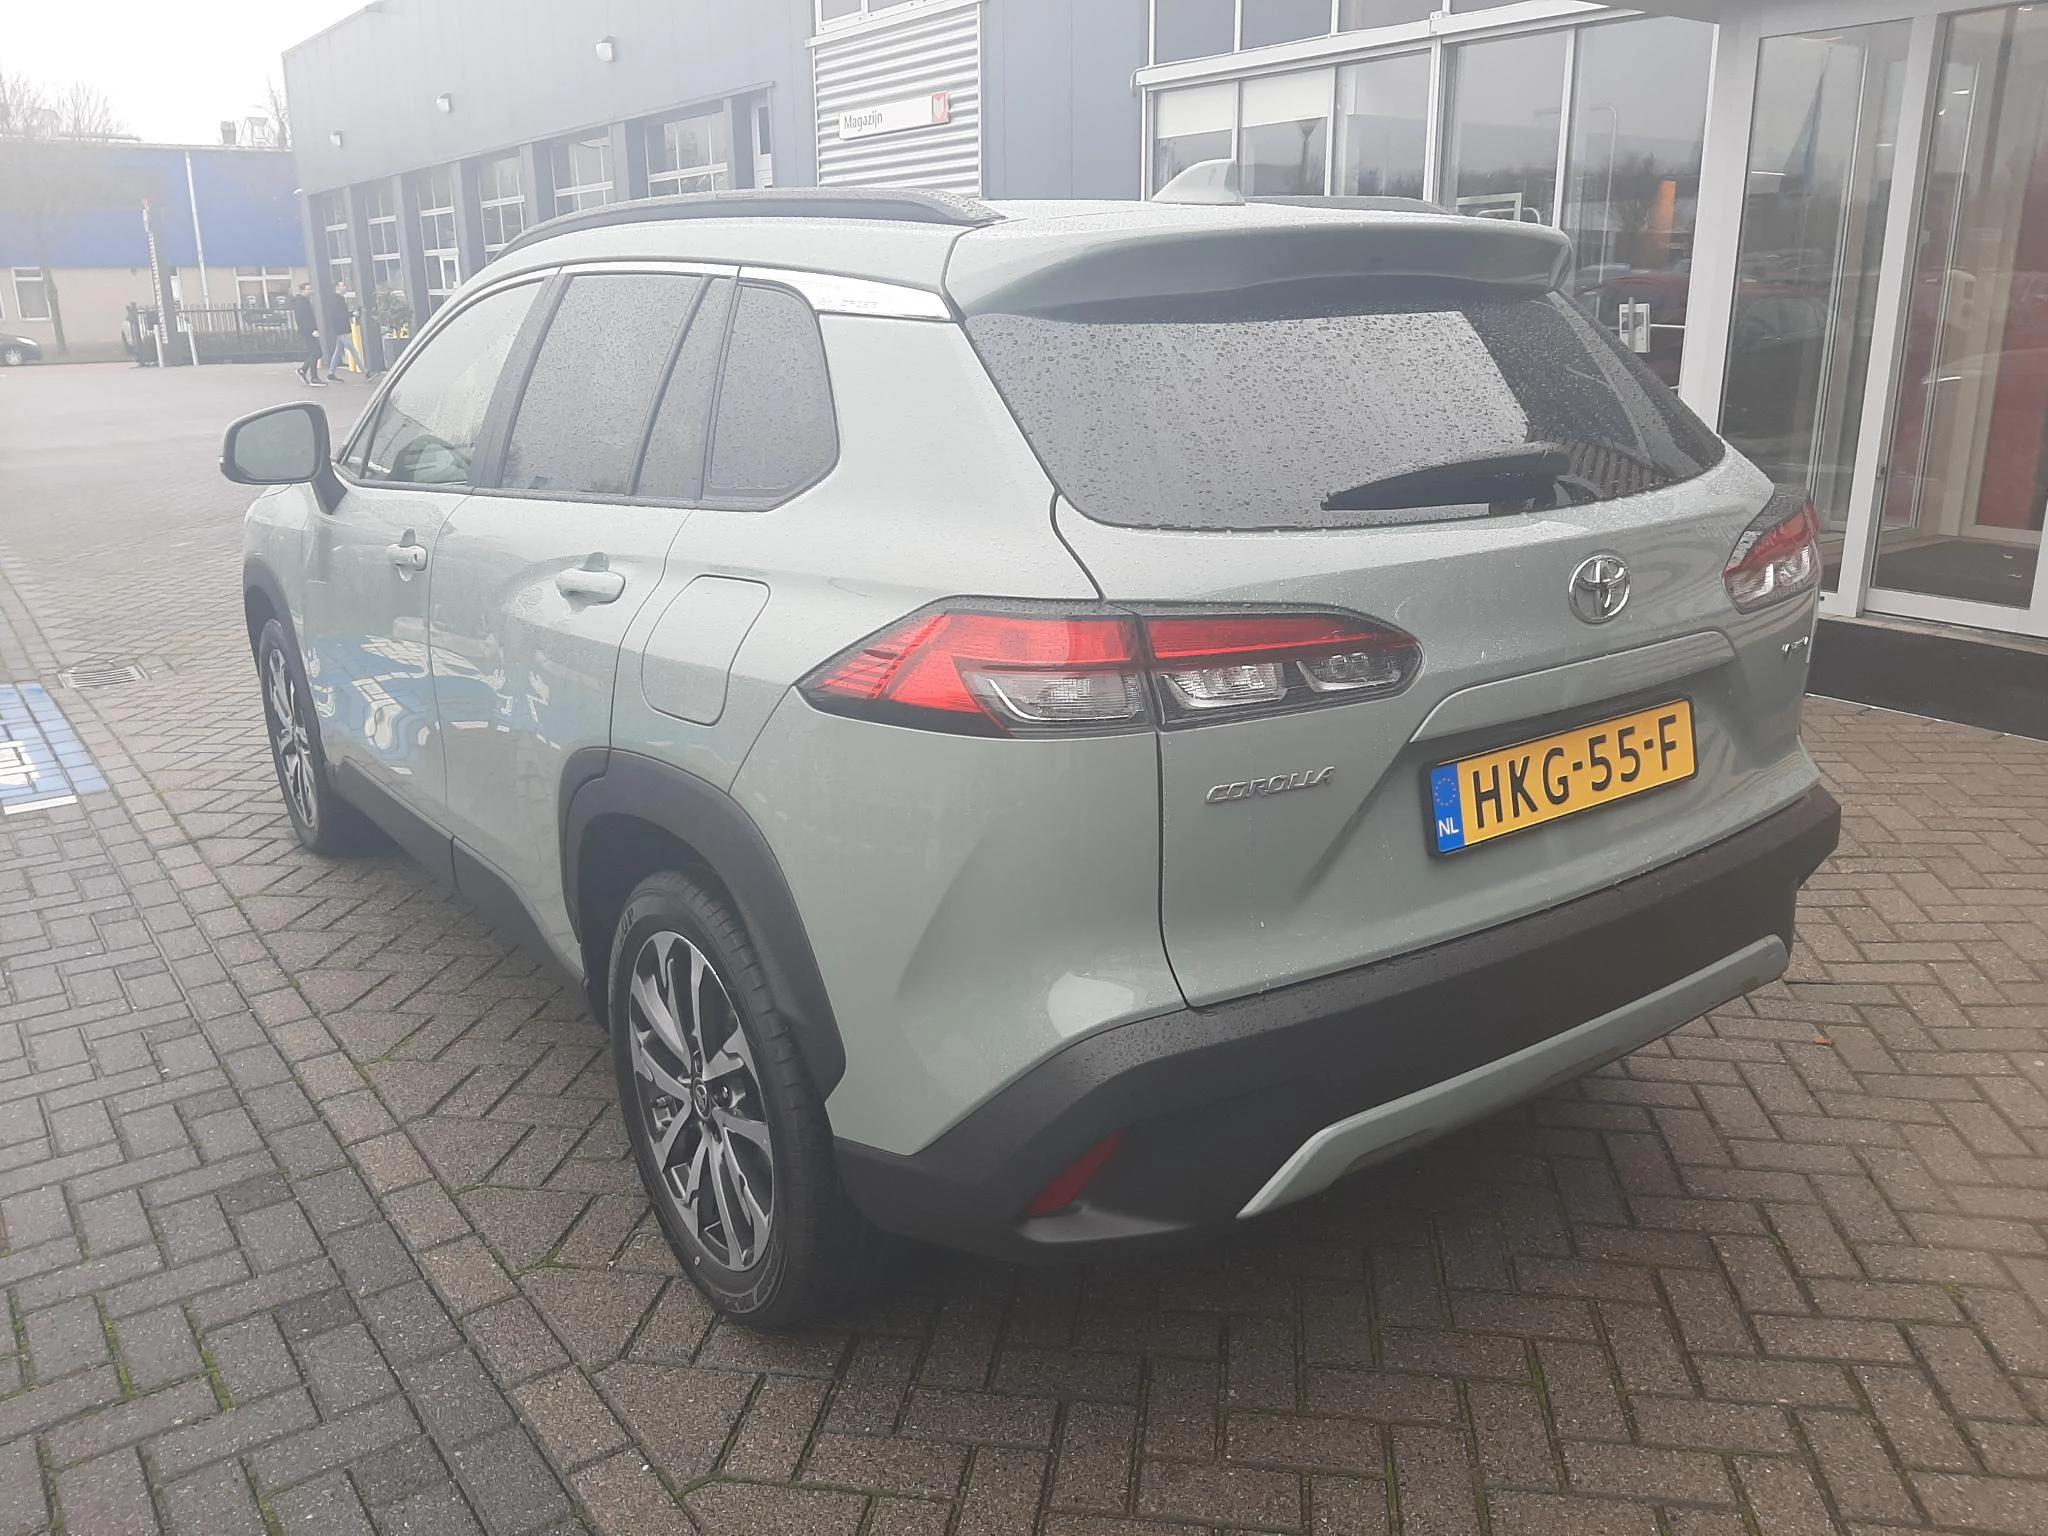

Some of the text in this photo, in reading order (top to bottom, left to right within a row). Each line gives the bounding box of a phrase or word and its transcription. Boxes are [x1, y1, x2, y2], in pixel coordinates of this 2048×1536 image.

[844, 110, 883, 132] Magazijn
[1205, 766, 1336, 804] COROLLA
[1472, 714, 1678, 829] HKG-55-F
[1438, 817, 1460, 838] NL
